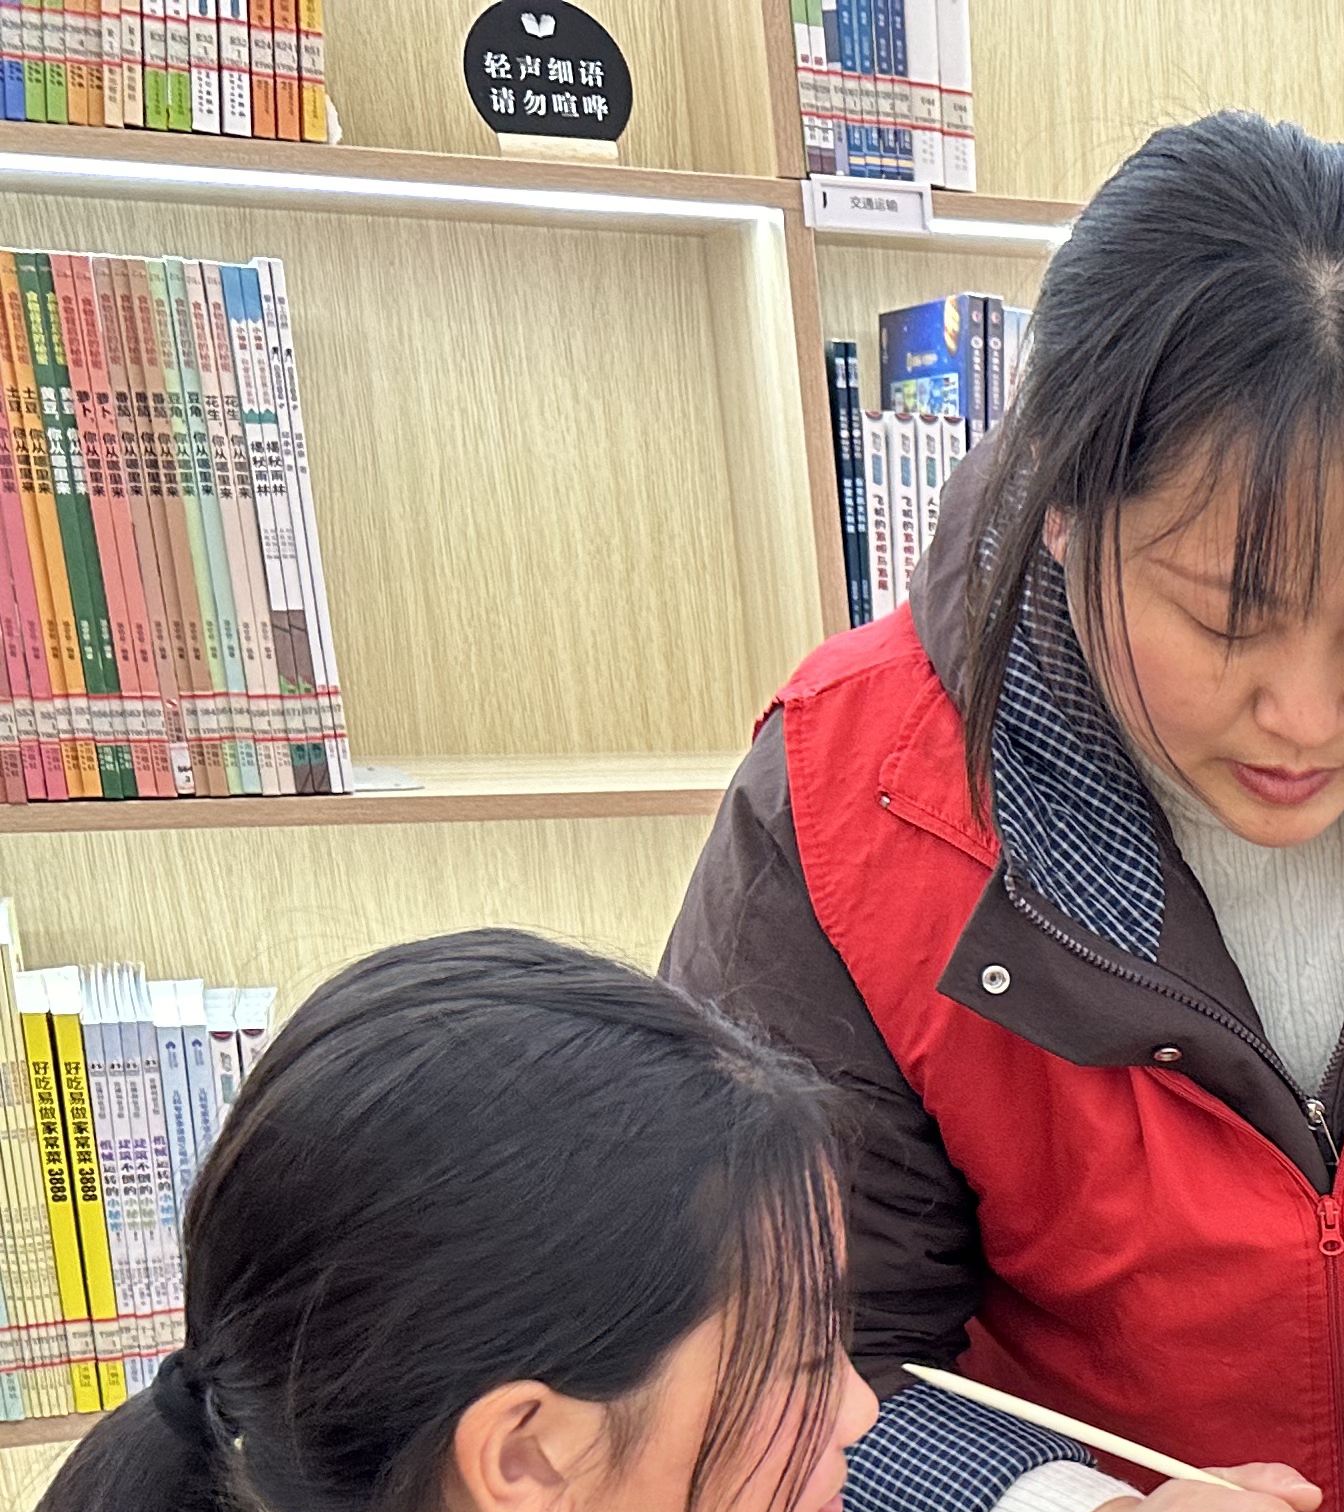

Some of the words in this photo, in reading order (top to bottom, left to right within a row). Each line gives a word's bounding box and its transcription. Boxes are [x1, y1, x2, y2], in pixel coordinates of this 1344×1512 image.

[483, 51, 605, 88] 轻声细语
[489, 86, 609, 121] 请勿喧哗
[849, 195, 899, 213] 交通运输
